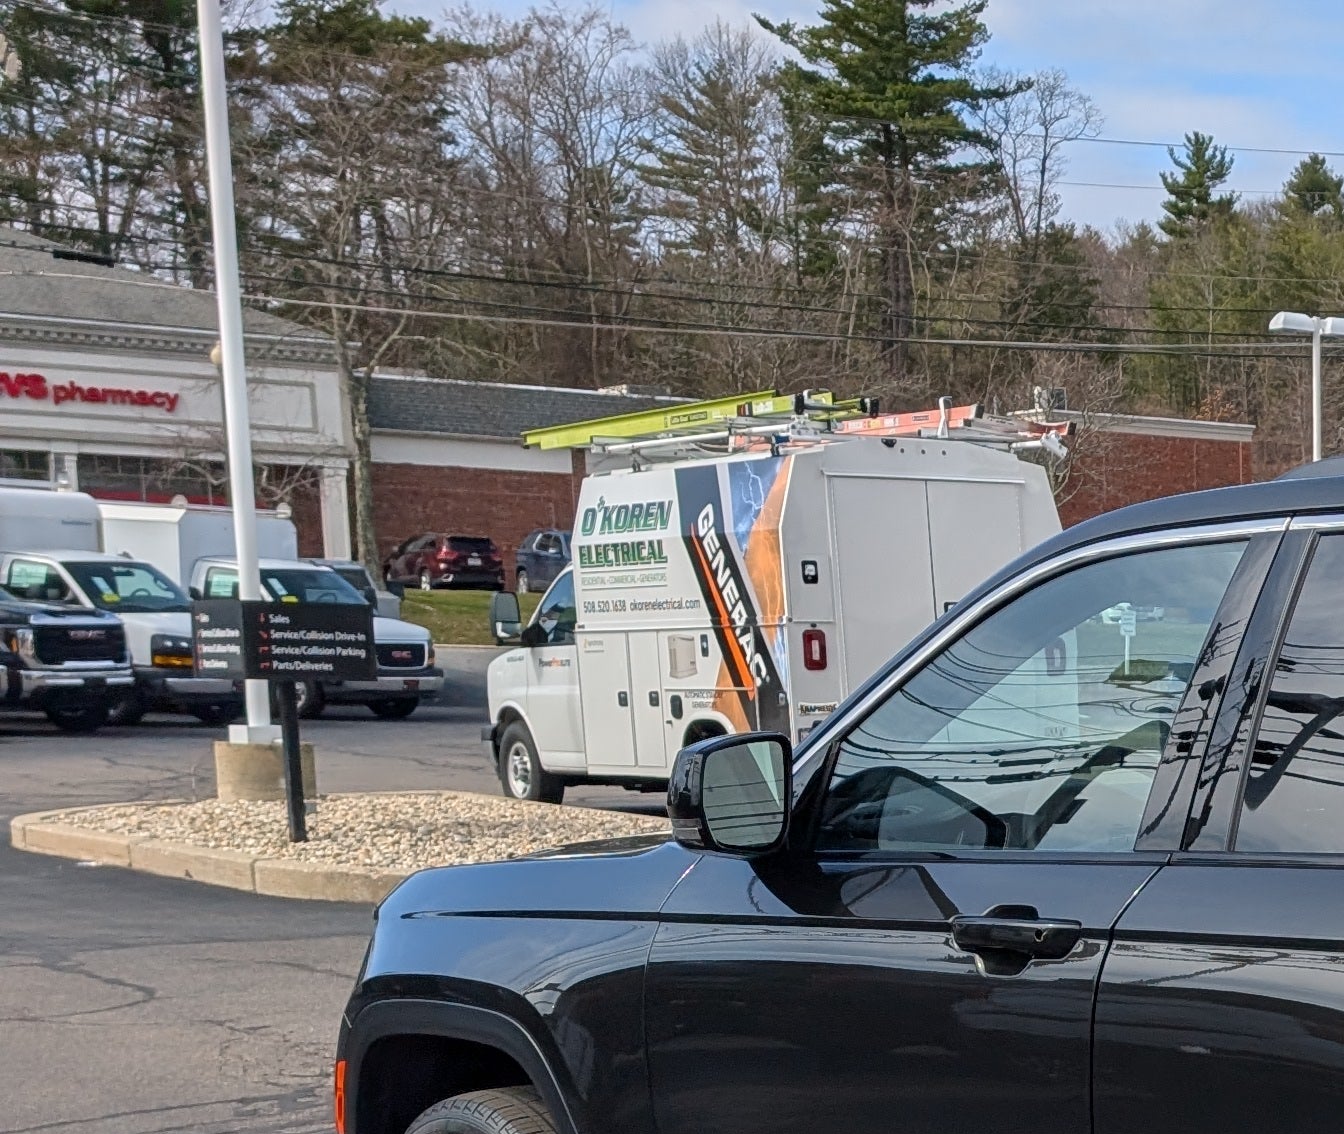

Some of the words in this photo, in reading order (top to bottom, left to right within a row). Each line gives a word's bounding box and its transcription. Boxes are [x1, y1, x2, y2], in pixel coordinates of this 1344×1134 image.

[0, 372, 48, 399] VS
[53, 380, 179, 412] pharmacy
[581, 496, 673, 536] O'KOREN
[578, 540, 668, 569] ELECTRICAL
[698, 503, 767, 687] GENERAC
[583, 599, 626, 614] 508.520.1638
[629, 597, 700, 611] okorenelectrical.com
[268, 613, 290, 624] Sales
[269, 630, 334, 641] Service/Collision
[335, 632, 366, 642] Drive-In
[271, 645, 336, 657] Service/Collision
[336, 646, 367, 659] Parking
[272, 660, 334, 672] Parts/Deliveries
